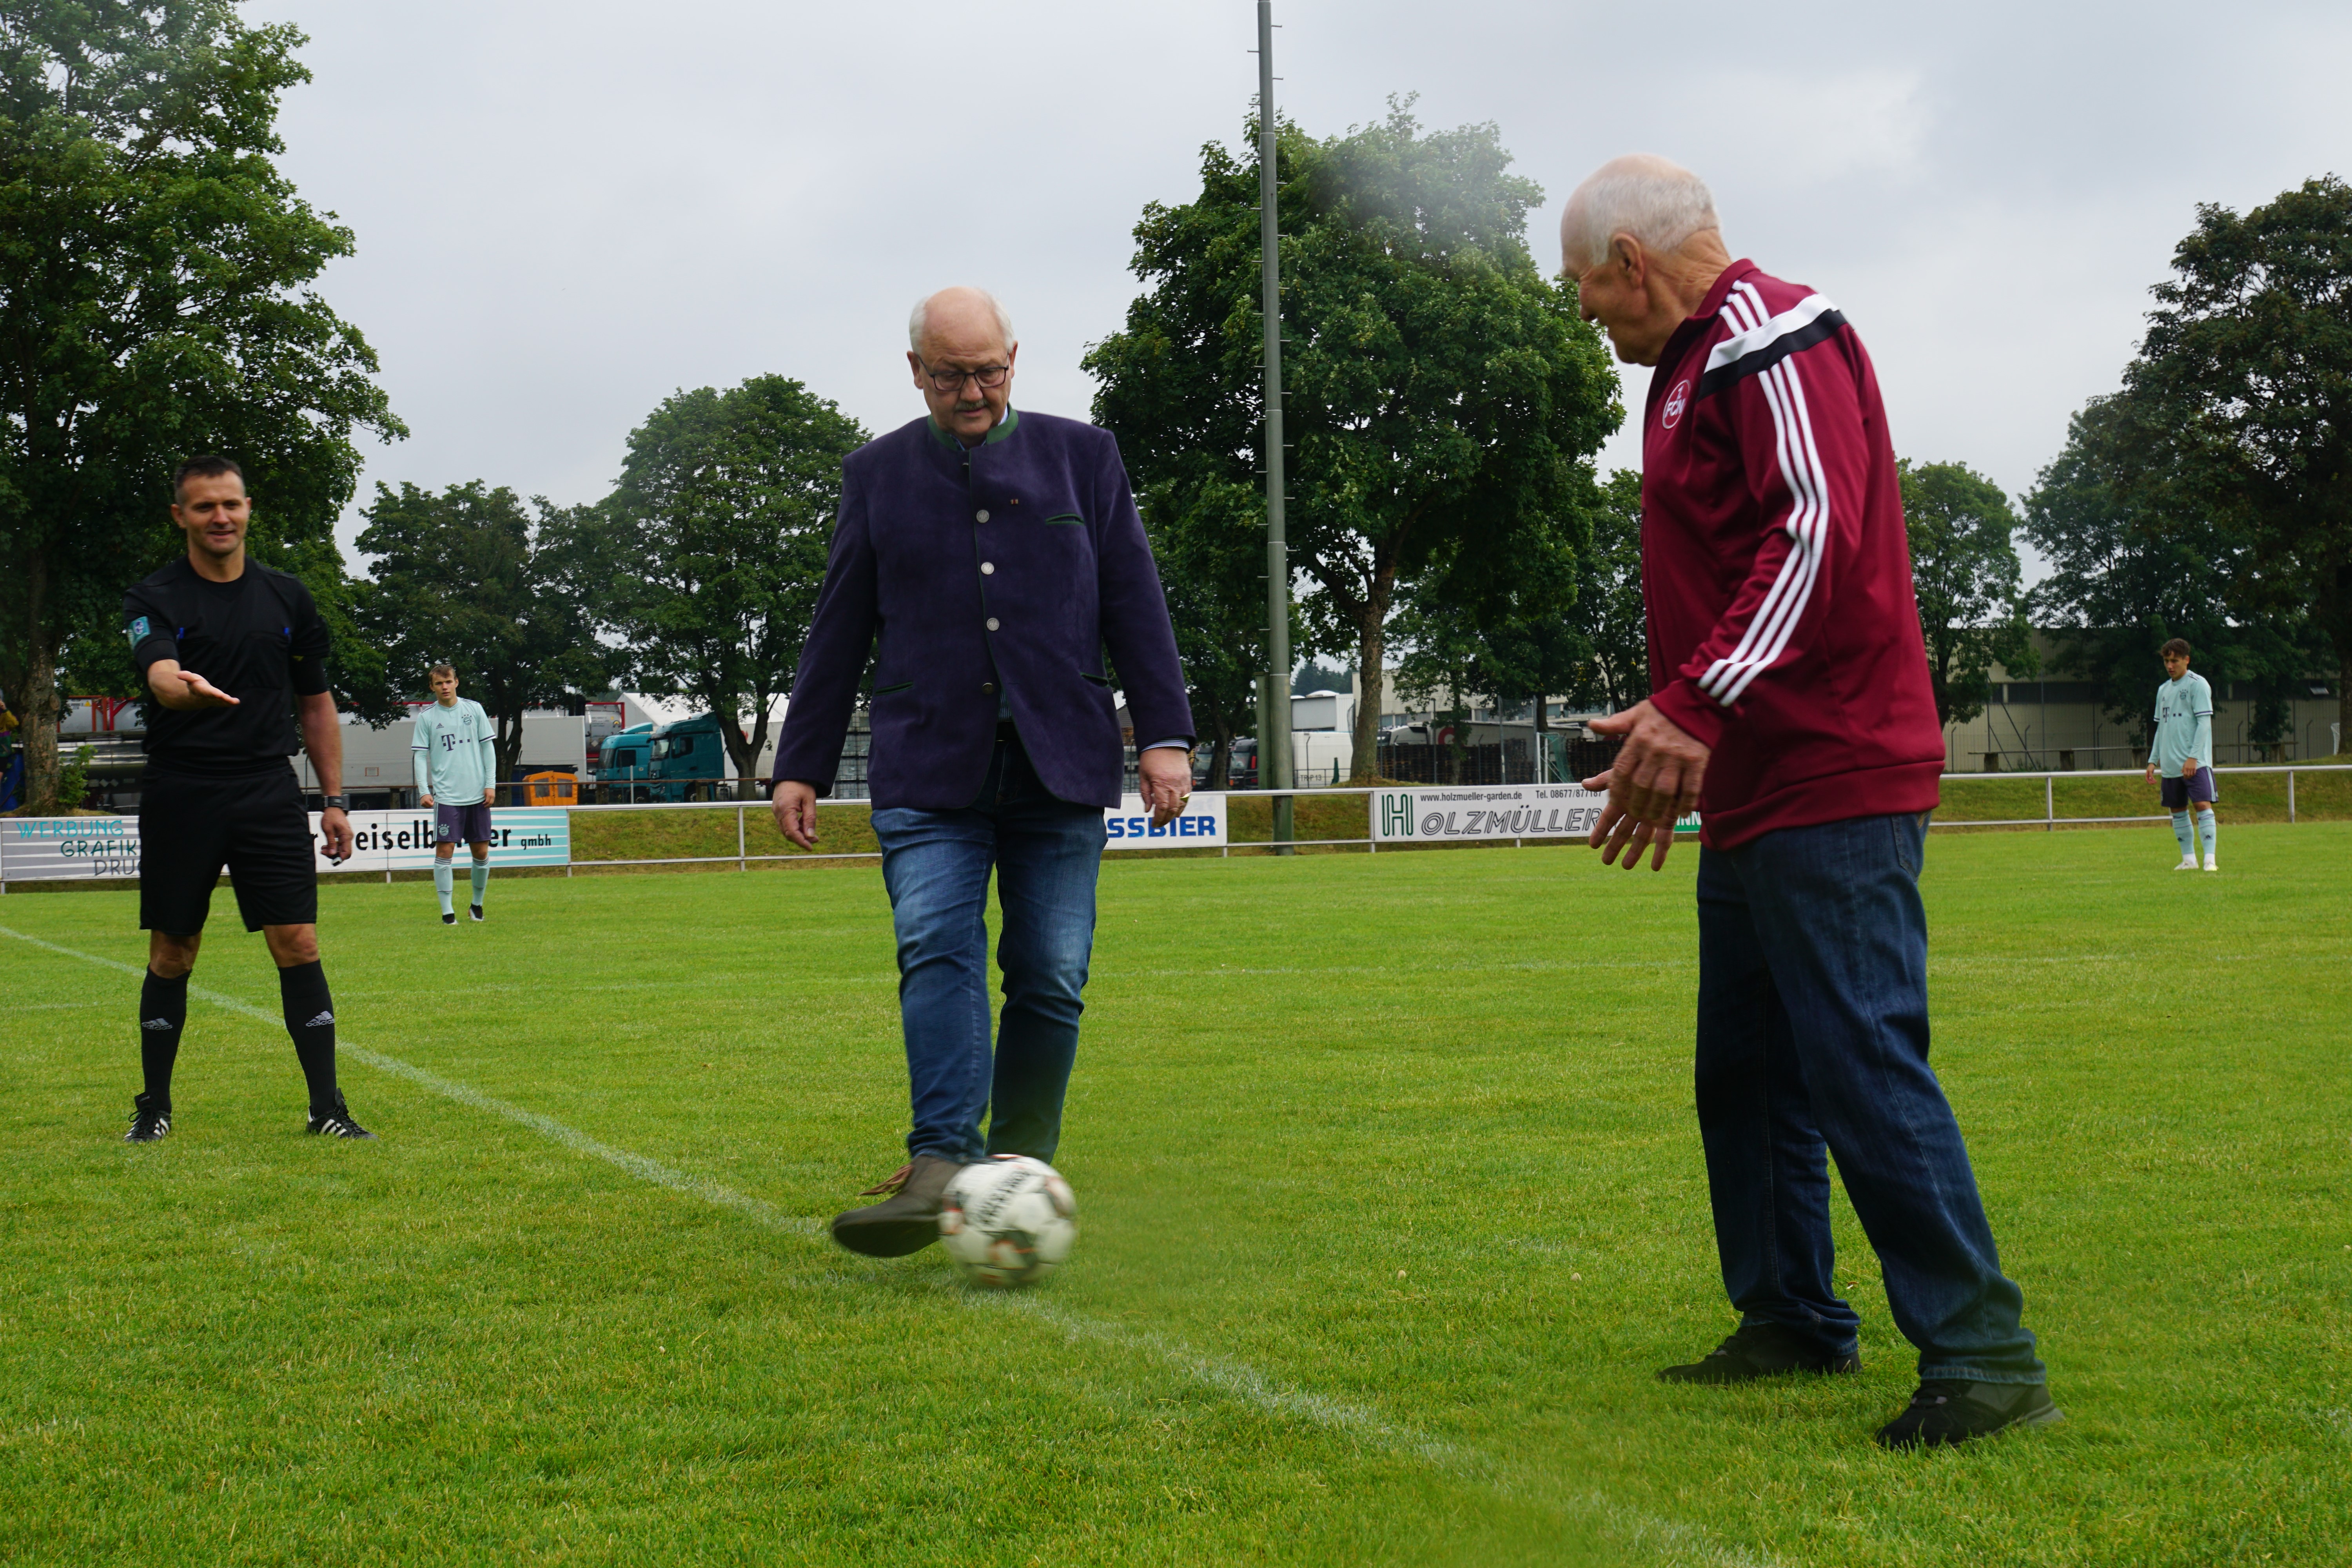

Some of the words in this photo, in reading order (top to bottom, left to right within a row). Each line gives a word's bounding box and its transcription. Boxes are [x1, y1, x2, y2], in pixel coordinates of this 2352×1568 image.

[1664, 398, 1686, 418] FCN
[1420, 792, 1522, 802] www.holzmueller-garden.de
[1535, 790, 1548, 799] Tel.
[16, 820, 123, 838] WERBUNG
[60, 840, 136, 857] GRAFIK
[521, 834, 551, 850] gmbh
[93, 859, 141, 876] DRU
[305, 1018, 335, 1027] adidas
